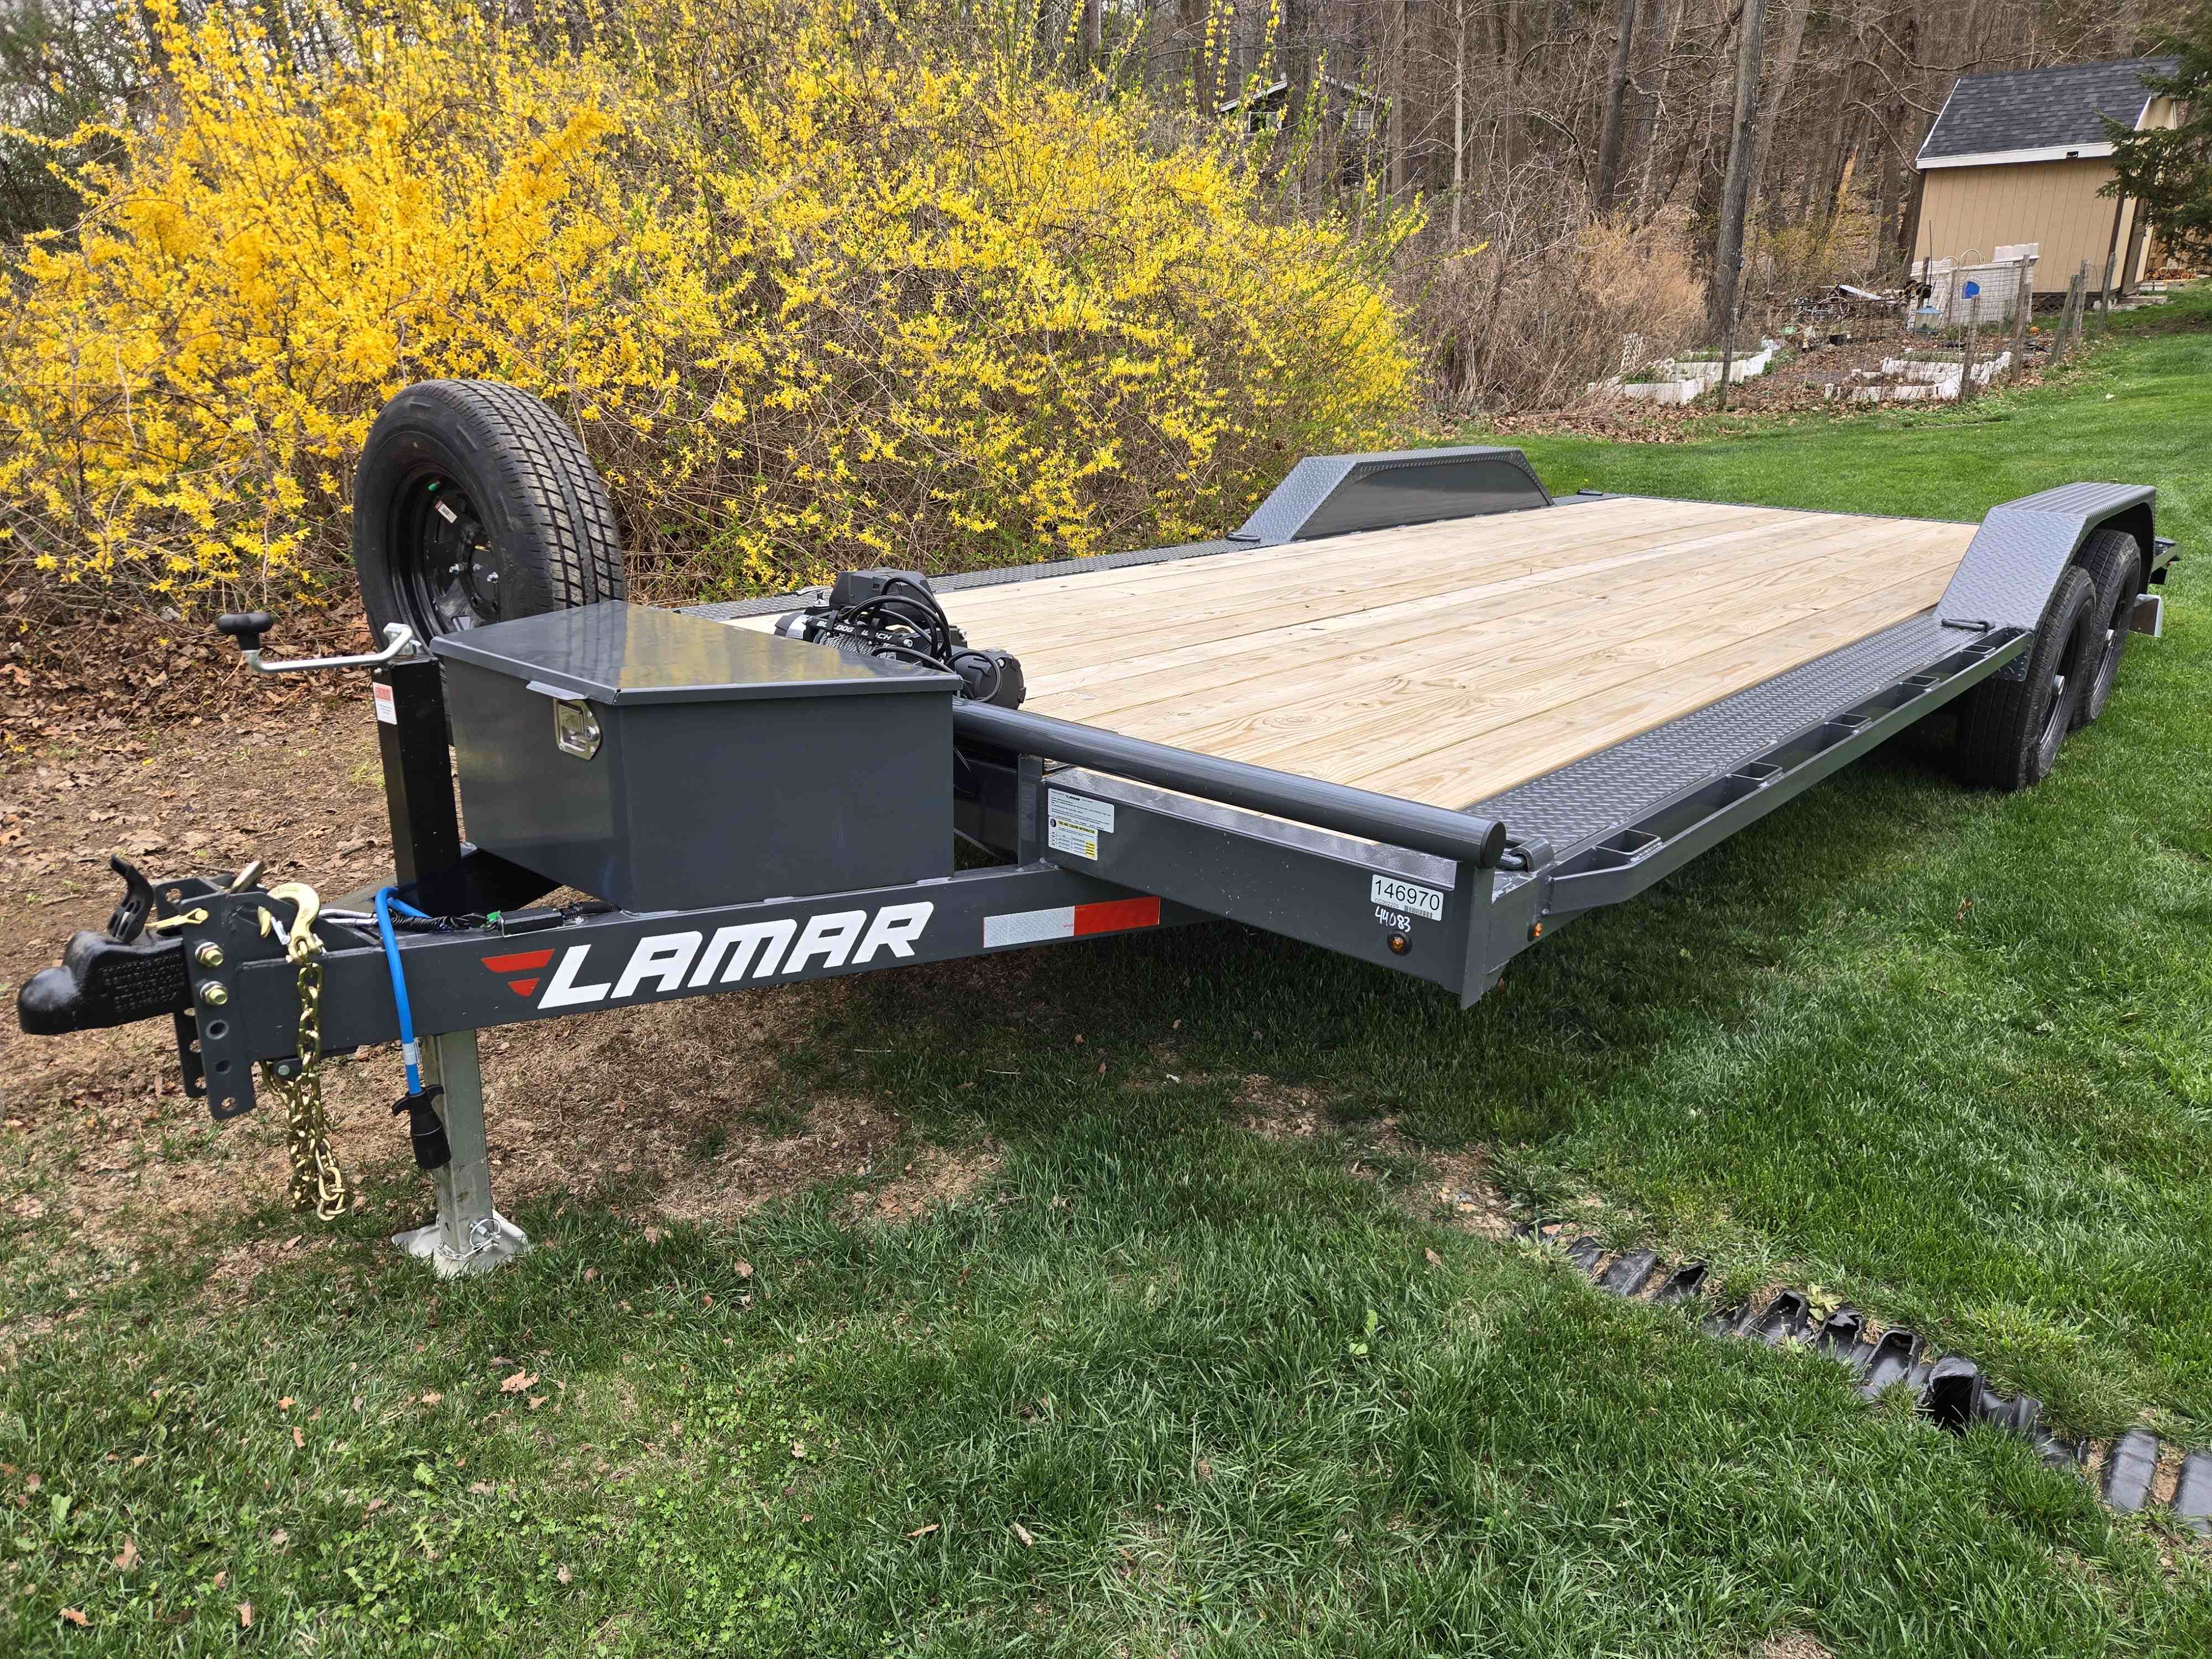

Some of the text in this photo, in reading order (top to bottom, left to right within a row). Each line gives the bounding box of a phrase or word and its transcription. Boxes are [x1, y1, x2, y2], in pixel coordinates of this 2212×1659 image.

[816, 620, 893, 640] BUDOG WCH
[1375, 880, 1440, 911] 146970
[1375, 905, 1411, 933] 44083
[538, 901, 933, 1010] LAMAR
